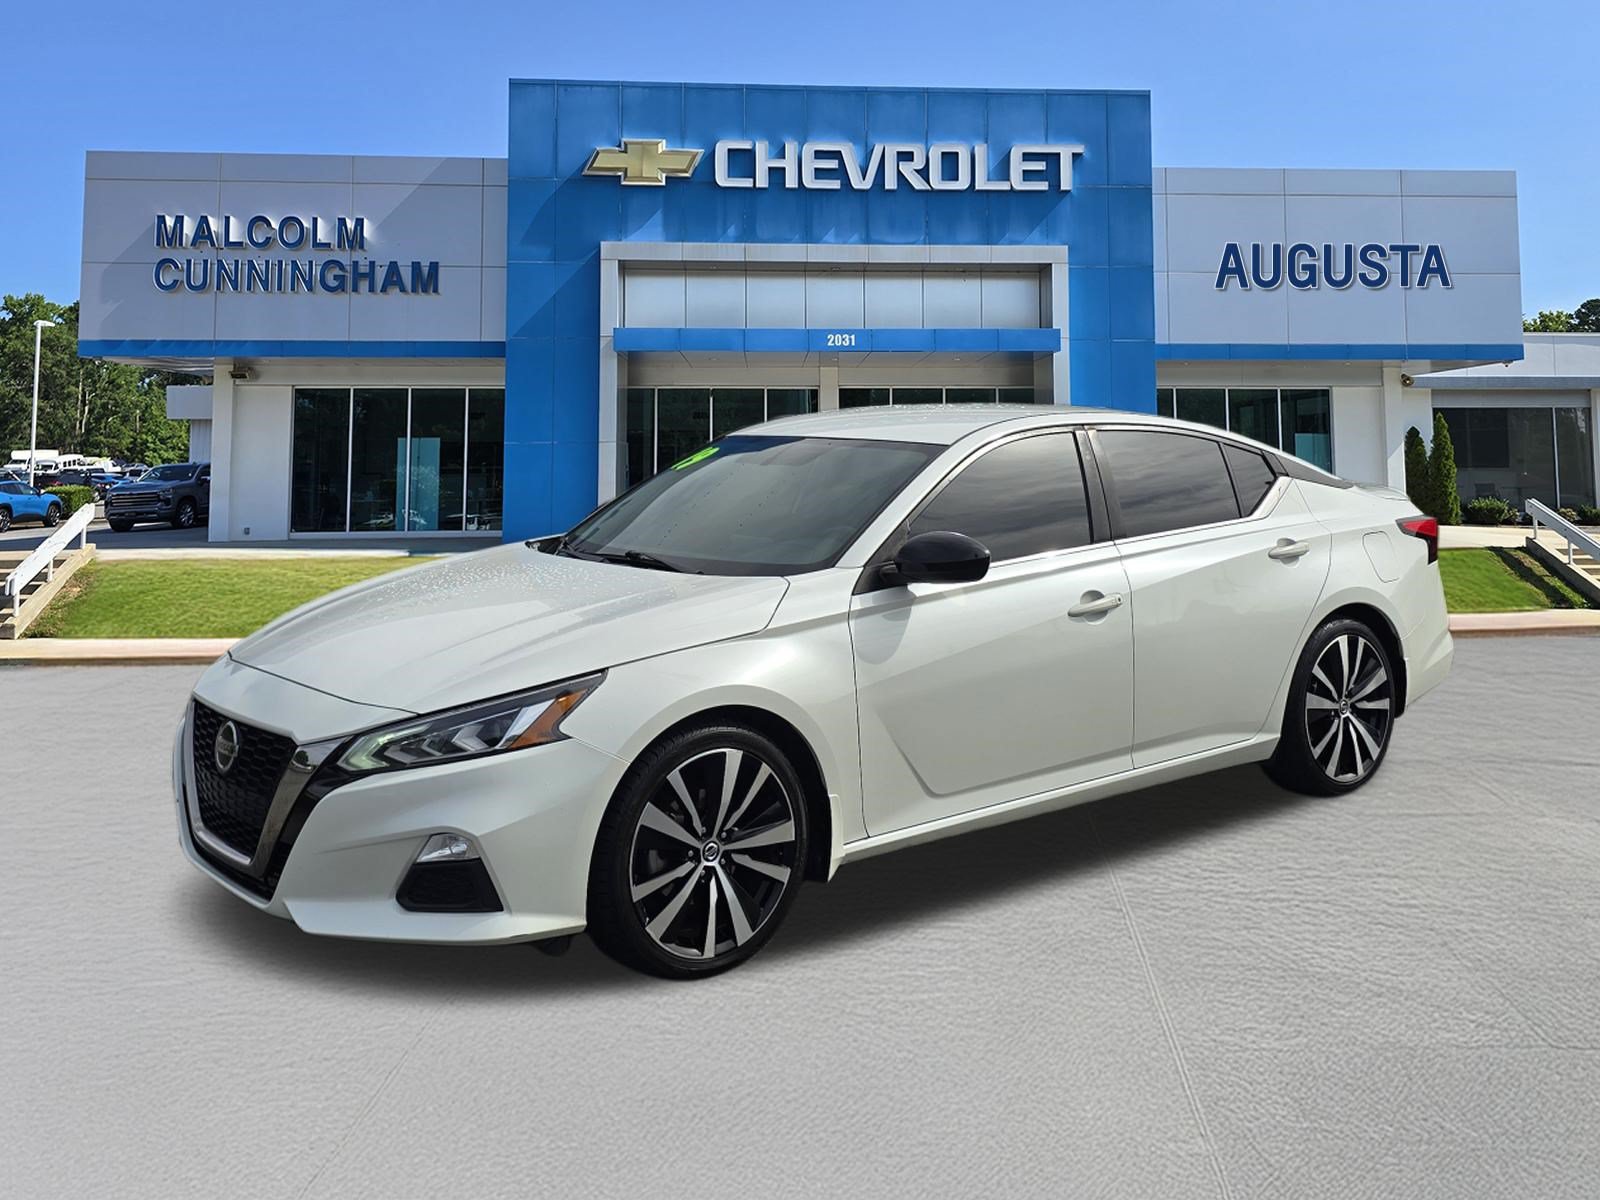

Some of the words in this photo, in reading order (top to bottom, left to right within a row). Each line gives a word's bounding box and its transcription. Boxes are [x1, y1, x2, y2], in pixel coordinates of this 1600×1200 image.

[714, 139, 1085, 192] CHEVROLET
[154, 213, 367, 250] MALCOLM
[153, 257, 441, 295] CUNNINGHAM
[1215, 241, 1452, 289] AUGUSTA
[827, 333, 856, 347] 2031
